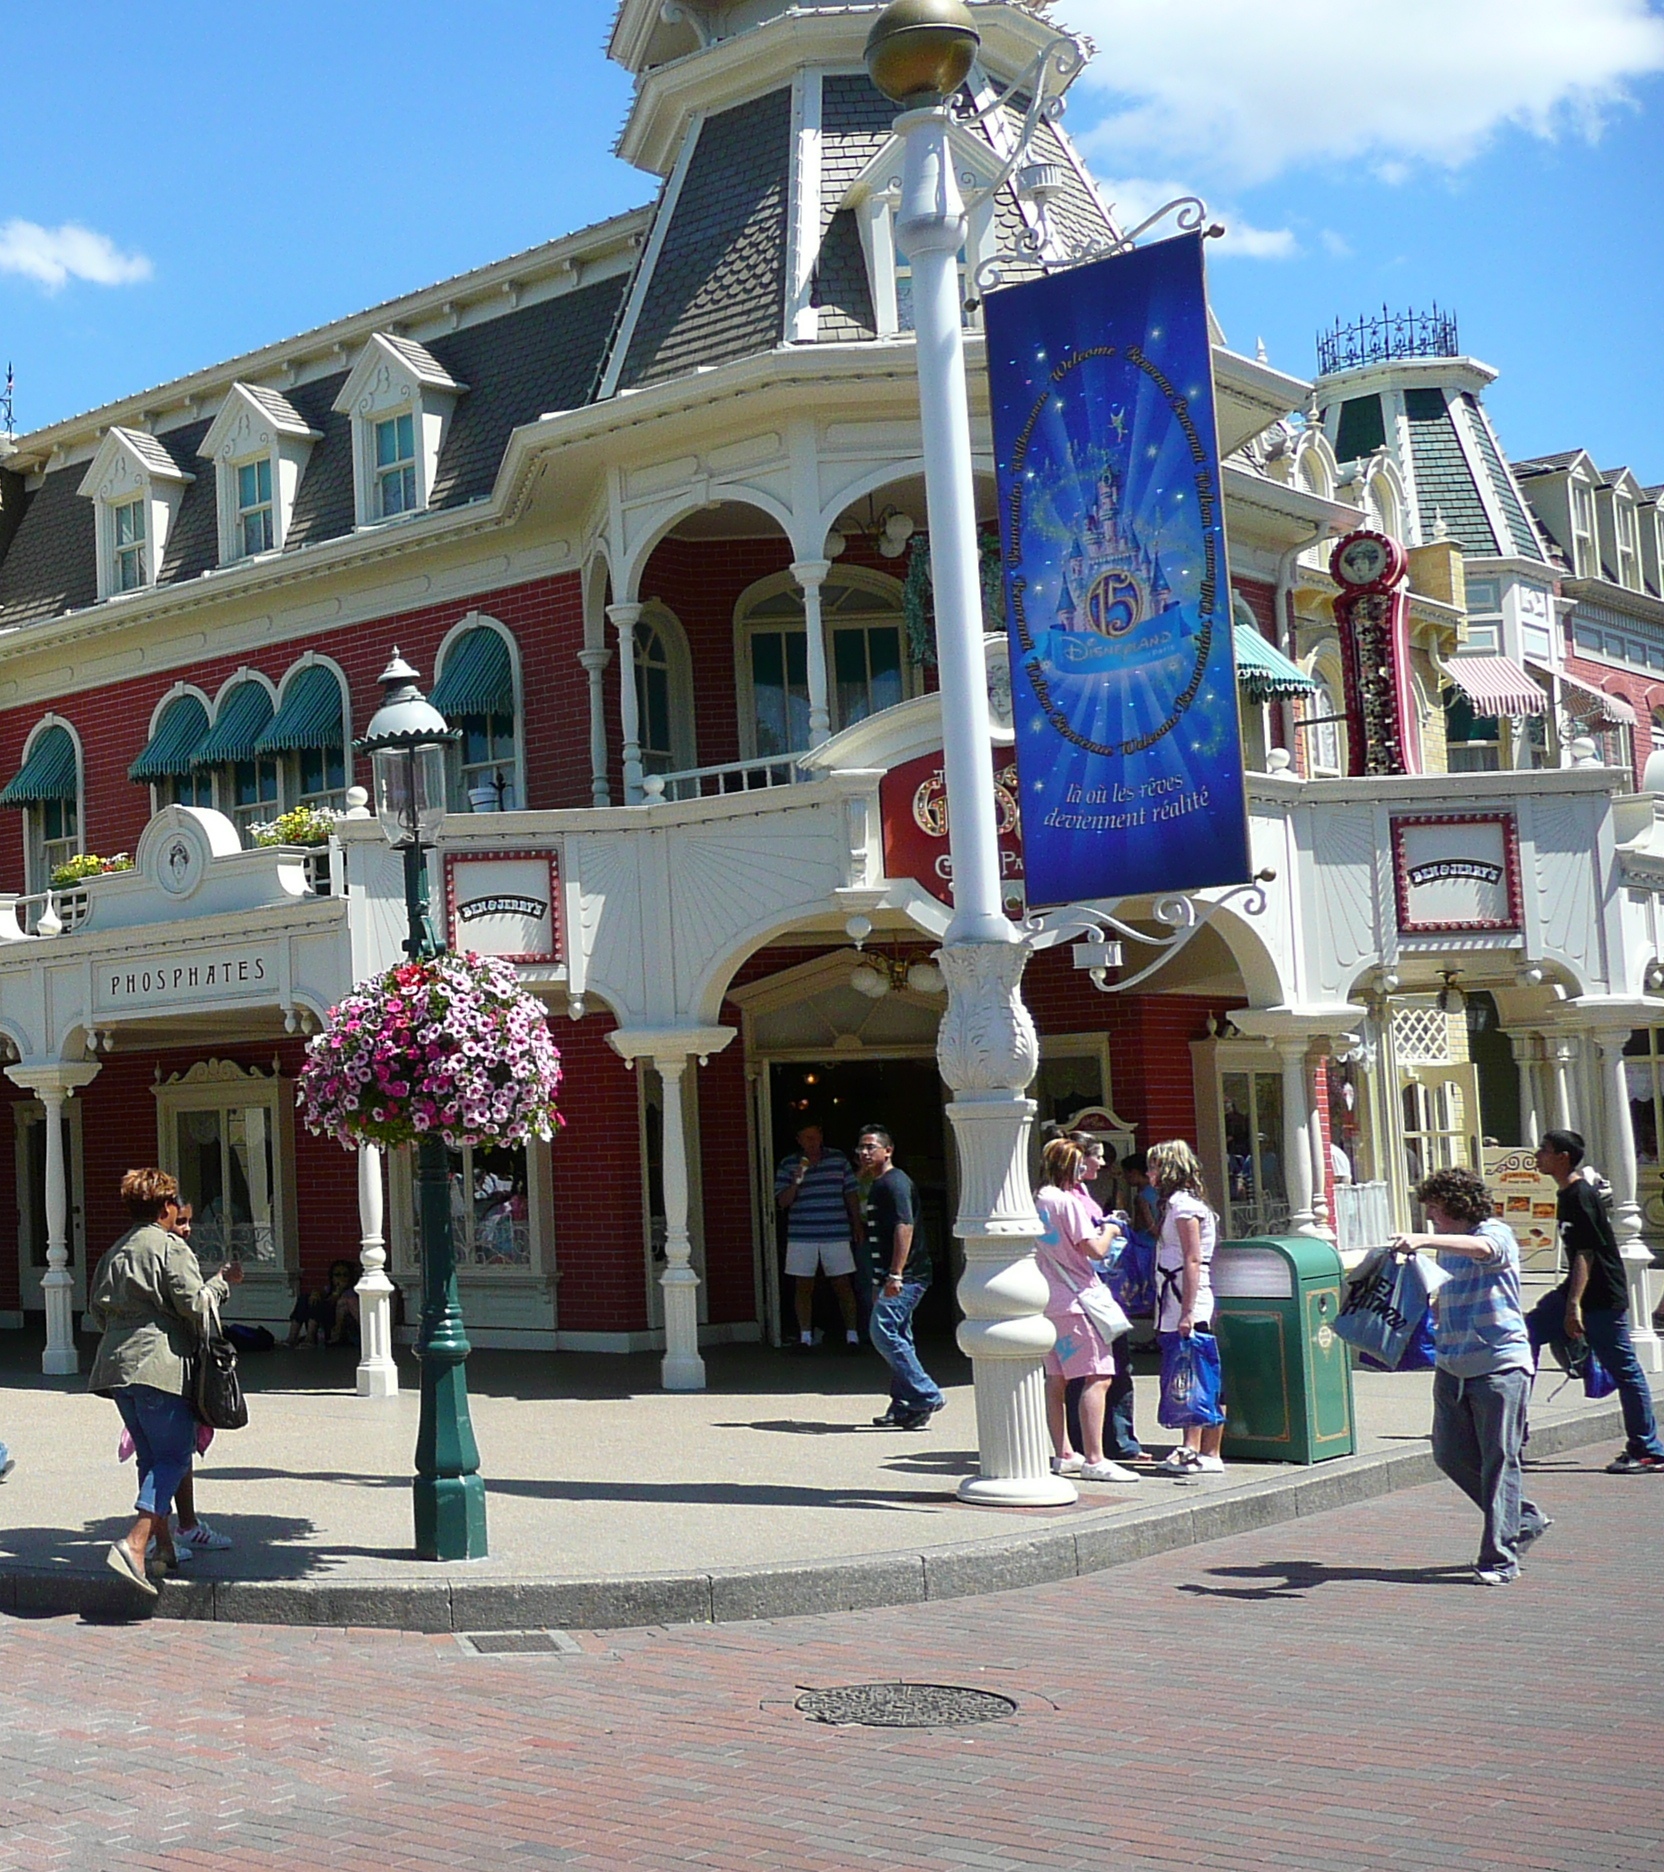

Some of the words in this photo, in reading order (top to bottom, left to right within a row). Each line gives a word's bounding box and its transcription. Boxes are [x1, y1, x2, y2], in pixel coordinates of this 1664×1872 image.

[1049, 345, 1115, 382] Welcome
[1125, 344, 1174, 398] Bienvenue
[1194, 467, 1214, 529] Welkom
[1090, 571, 1138, 638] 15
[1119, 712, 1181, 755] Welcome
[1043, 807, 1146, 829] deviennent
[1152, 785, 1209, 822] réalité
[1066, 783, 1082, 803] là
[1086, 784, 1107, 804] où
[1112, 783, 1134, 803] les
[1140, 773, 1183, 798] rêves
[111, 958, 265, 995] PHOSPHATES
